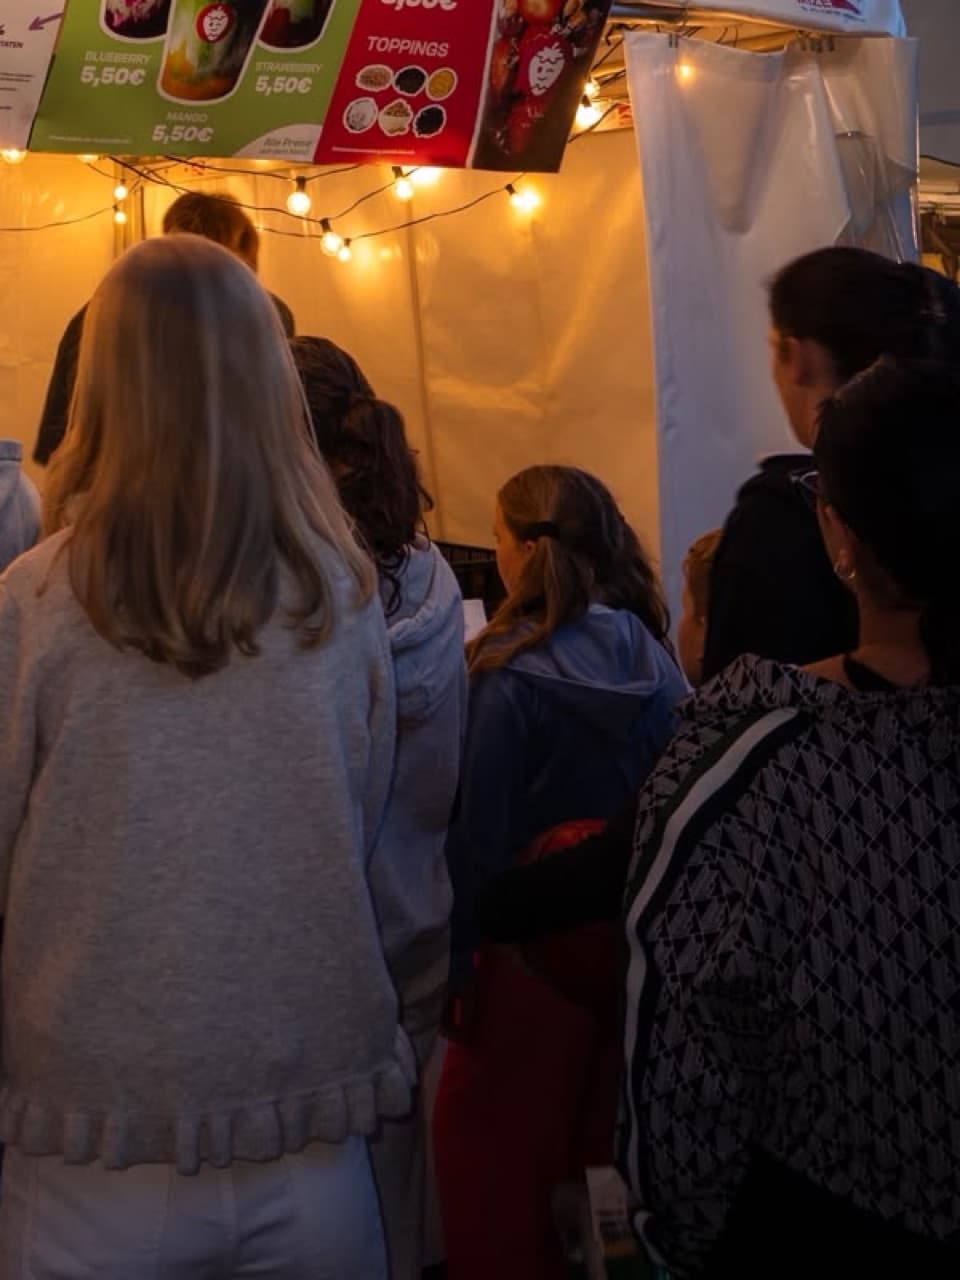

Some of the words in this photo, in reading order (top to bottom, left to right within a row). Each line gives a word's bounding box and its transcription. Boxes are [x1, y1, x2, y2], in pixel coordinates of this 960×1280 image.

[367, 35, 449, 58] TOPPINGS
[80, 66, 146, 88] 5,50€
[255, 76, 313, 95] 5,50€
[152, 124, 214, 145] 5,50€
